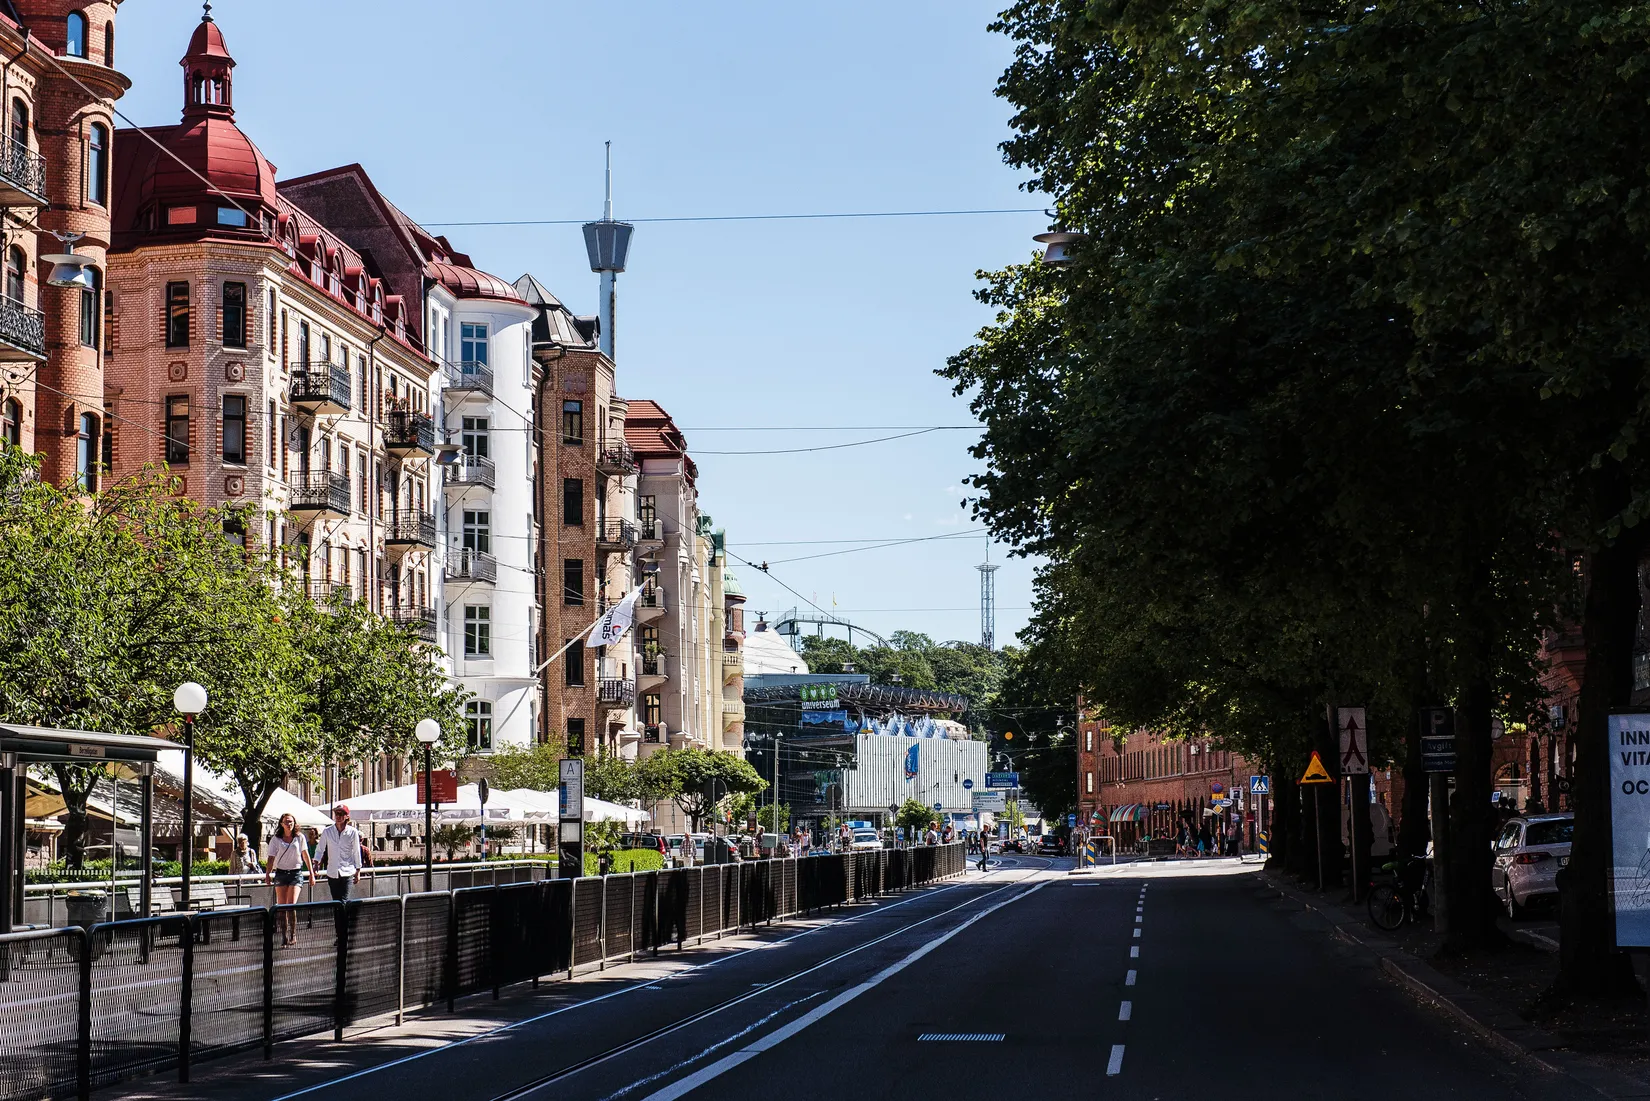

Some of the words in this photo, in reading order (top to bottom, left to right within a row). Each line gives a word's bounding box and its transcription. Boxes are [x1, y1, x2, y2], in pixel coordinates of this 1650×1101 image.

[801, 699, 841, 710] universeum
[1431, 711, 1446, 734] P
[1620, 730, 1650, 746] INN
[566, 762, 575, 775] A
